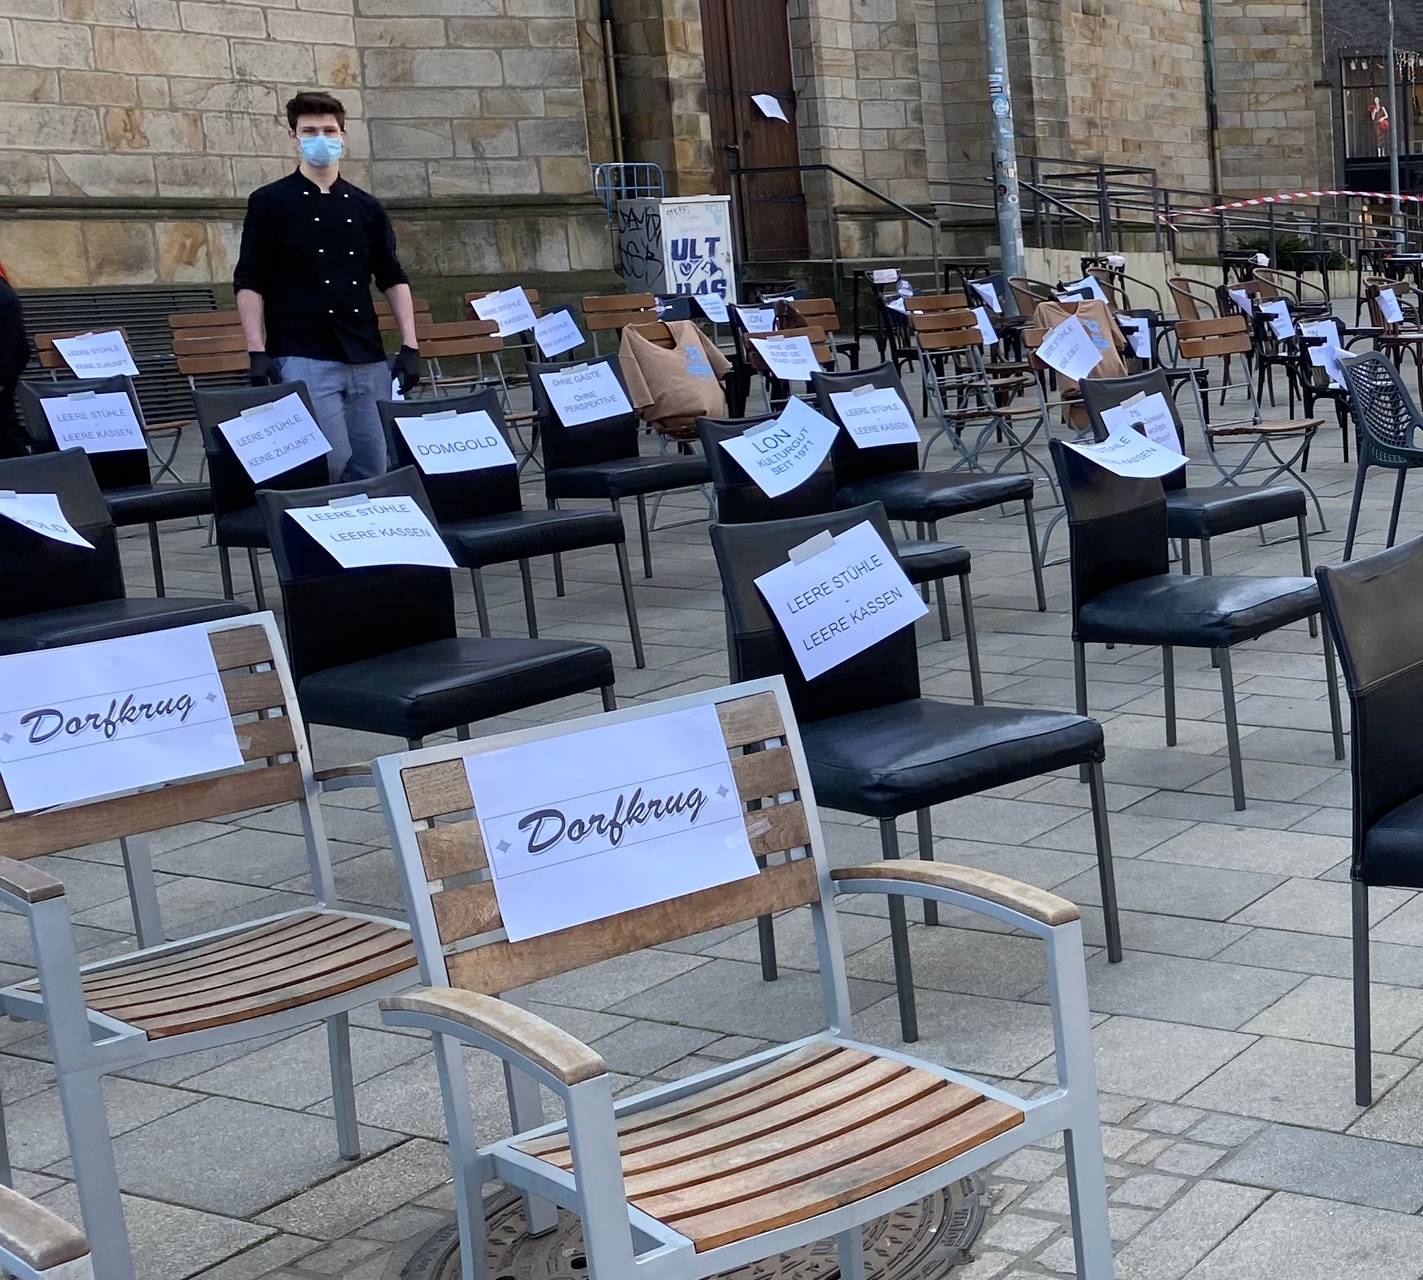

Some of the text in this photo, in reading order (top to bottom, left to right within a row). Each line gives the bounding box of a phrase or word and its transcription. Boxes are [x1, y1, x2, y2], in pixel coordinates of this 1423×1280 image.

[57, 408, 126, 422] LEERE STÜHLE
[844, 402, 900, 417] LEERE STÜHLE
[62, 428, 134, 442] LEERE KASSEN
[236, 413, 302, 447] LEERE STÜHLE
[752, 428, 792, 454] LON
[853, 421, 909, 435] LEERE KASSEN
[247, 432, 316, 468] KEINE ZUKUNFT
[416, 436, 498, 456] DOMGOLD
[757, 426, 810, 468] KULTURGUT
[770, 440, 815, 476] SEIT 1971
[307, 503, 411, 522] LEERE STÜHLE
[330, 527, 431, 542] LEERE KASSEN
[786, 554, 884, 614] LEERE STÜHLE
[802, 587, 903, 651] LEERE KASSEN
[20, 693, 196, 744] Dorfkrug
[518, 787, 708, 853] Dorfkrug
